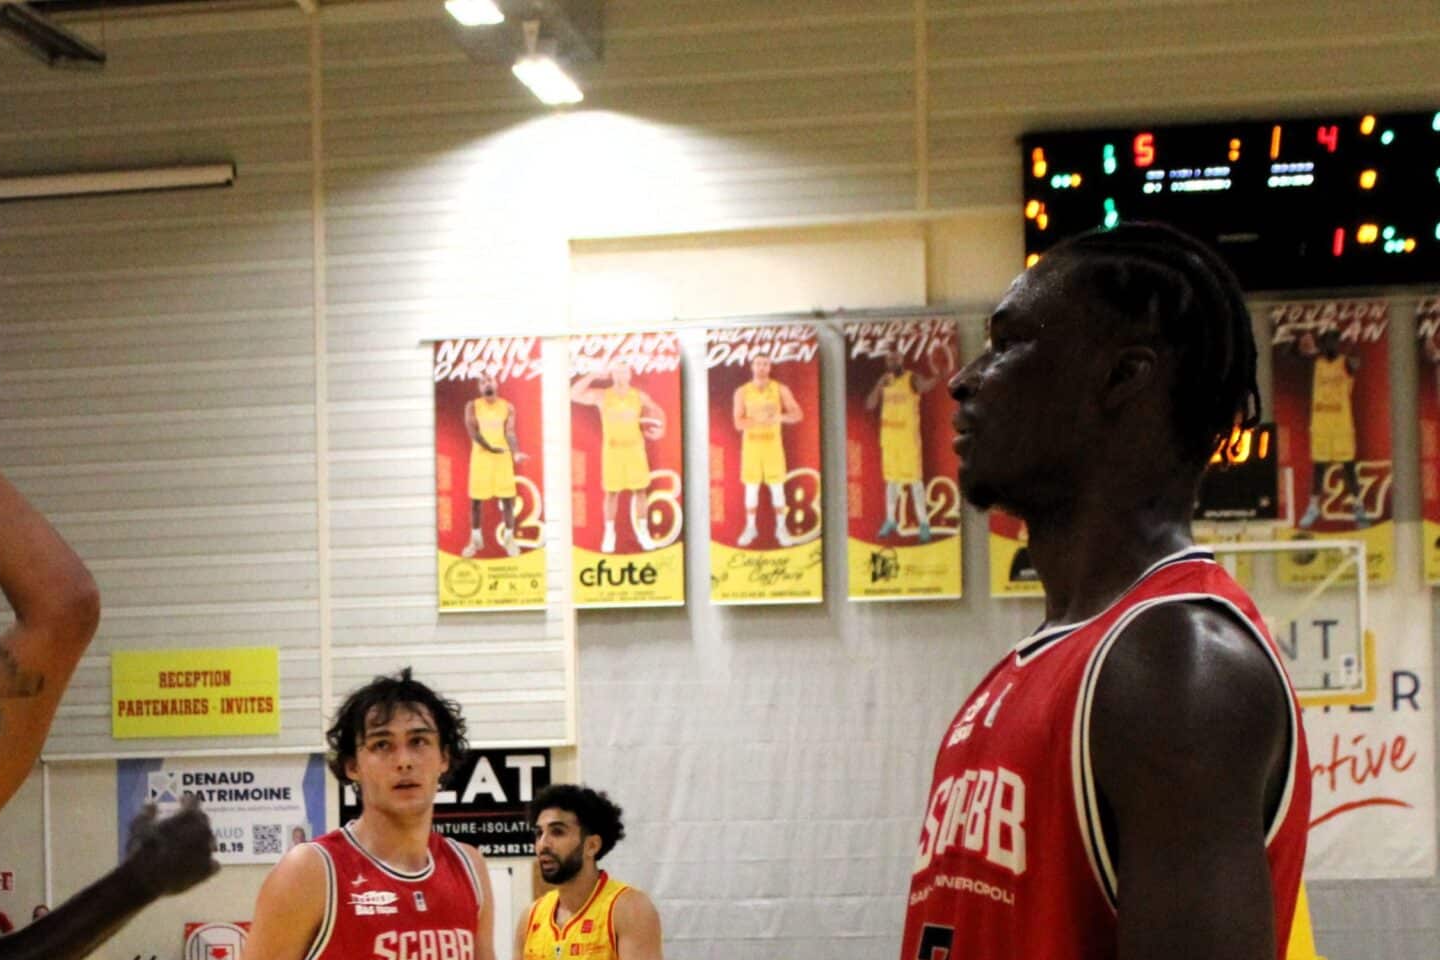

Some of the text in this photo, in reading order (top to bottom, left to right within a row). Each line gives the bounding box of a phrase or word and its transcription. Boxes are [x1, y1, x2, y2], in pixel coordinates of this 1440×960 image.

[159, 670, 231, 688] RECEPTION
[117, 698, 209, 717] PARTENAIRES
[220, 696, 274, 714] INVITES
[182, 771, 254, 785] DENAUD
